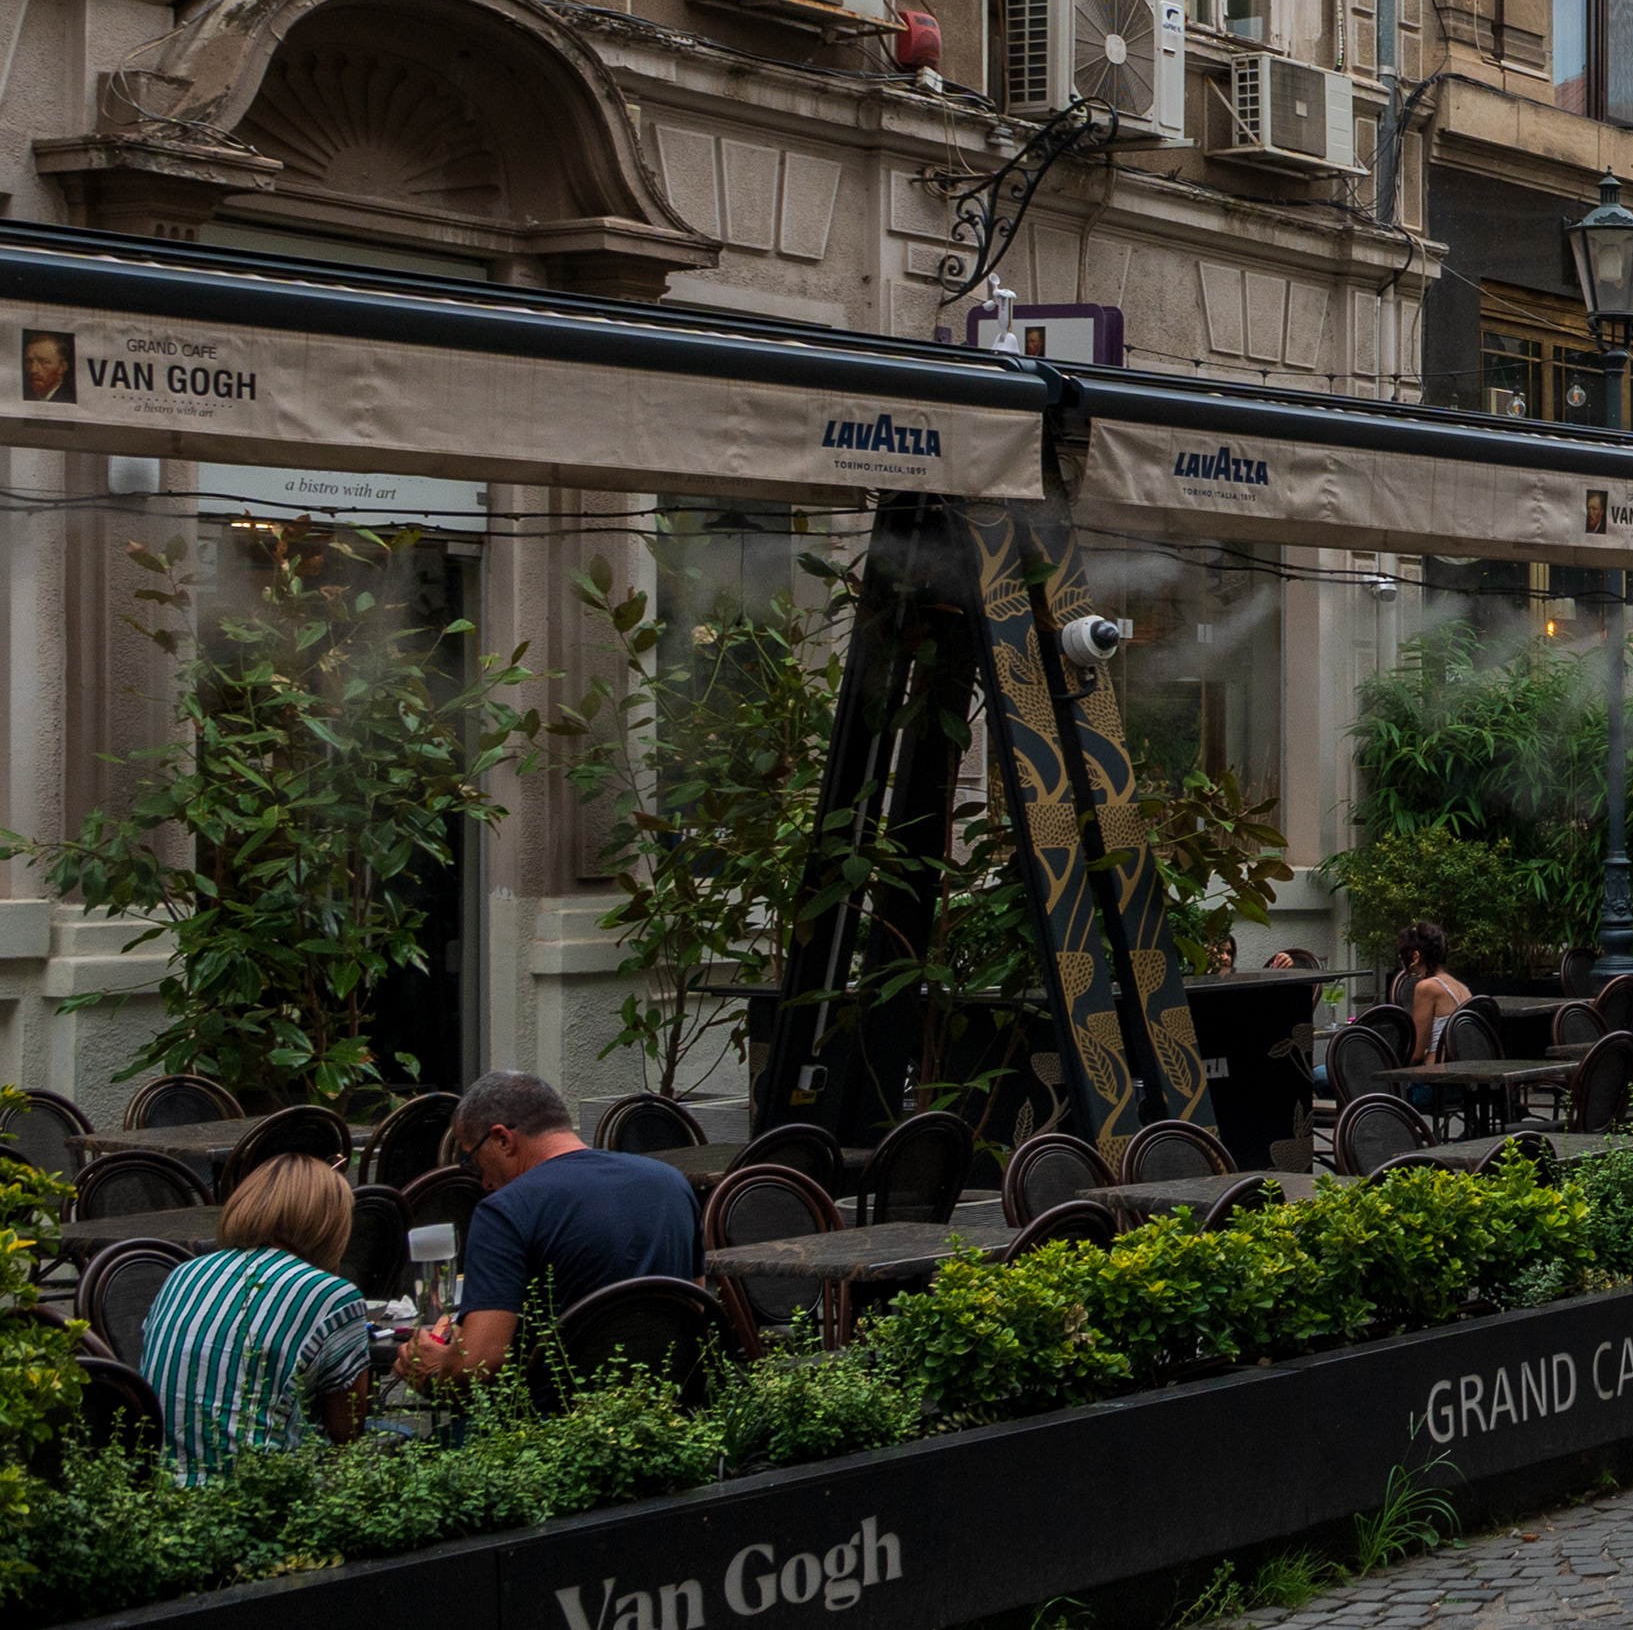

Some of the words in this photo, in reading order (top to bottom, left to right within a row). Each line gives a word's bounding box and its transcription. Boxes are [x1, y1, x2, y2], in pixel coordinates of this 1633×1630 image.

[126, 338, 178, 357] GRAND
[87, 357, 154, 391] VAN
[167, 364, 257, 401] GOGH
[143, 401, 174, 415] bistro
[176, 405, 198, 417] with
[821, 413, 942, 457] LAVAZZA
[1174, 446, 1269, 485] LAVAZZA
[285, 480, 294, 491] a
[299, 477, 339, 495] bistro
[343, 483, 373, 498] with
[376, 487, 397, 500] art
[1427, 1352, 1578, 1444] GRAND
[554, 1576, 706, 1630] Van
[723, 1514, 904, 1617] Gogh
